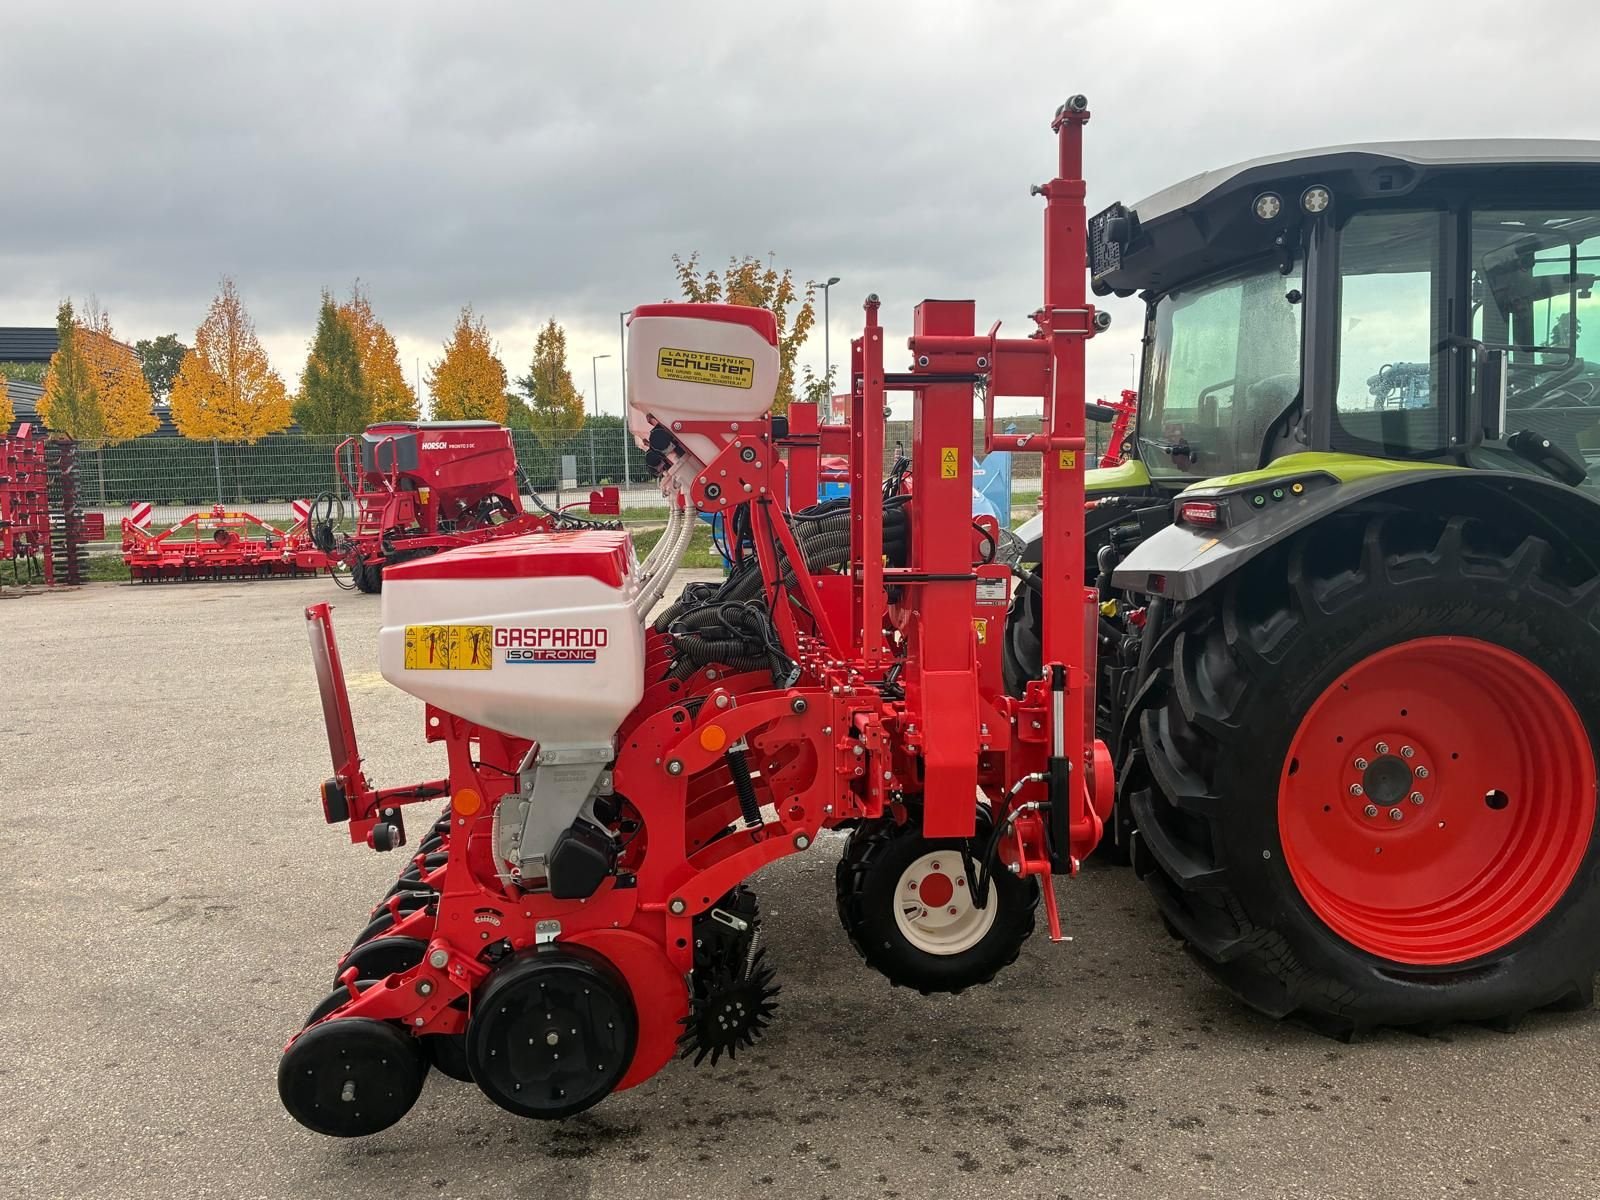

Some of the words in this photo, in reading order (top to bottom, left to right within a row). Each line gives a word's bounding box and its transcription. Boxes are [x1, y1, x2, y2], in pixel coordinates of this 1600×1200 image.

[668, 351, 745, 365] LANDTECHNIK
[422, 442, 447, 450] HORSCH
[495, 628, 607, 647] GASPARDO
[507, 650, 595, 659] ISOTRONIC
